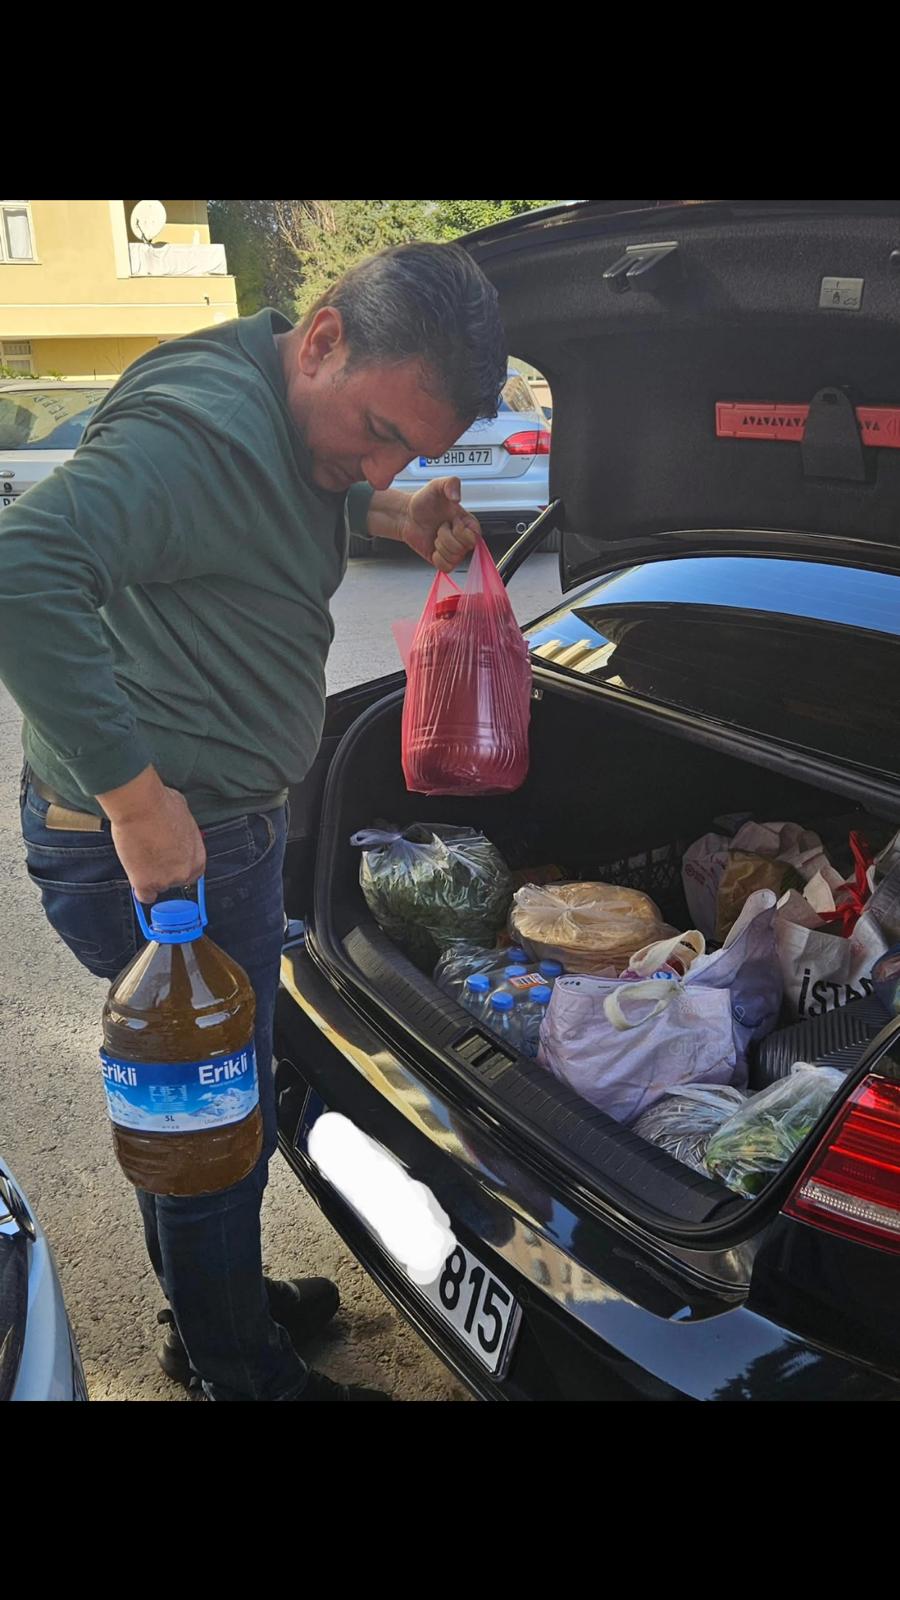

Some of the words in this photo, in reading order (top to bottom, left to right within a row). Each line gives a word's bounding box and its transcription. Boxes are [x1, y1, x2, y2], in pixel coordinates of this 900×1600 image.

[444, 451, 465, 464] BHD
[468, 450, 490, 463] 477
[100, 1058, 137, 1087] Erikli
[198, 1053, 247, 1085] Erikli
[439, 1244, 511, 1353] 815
